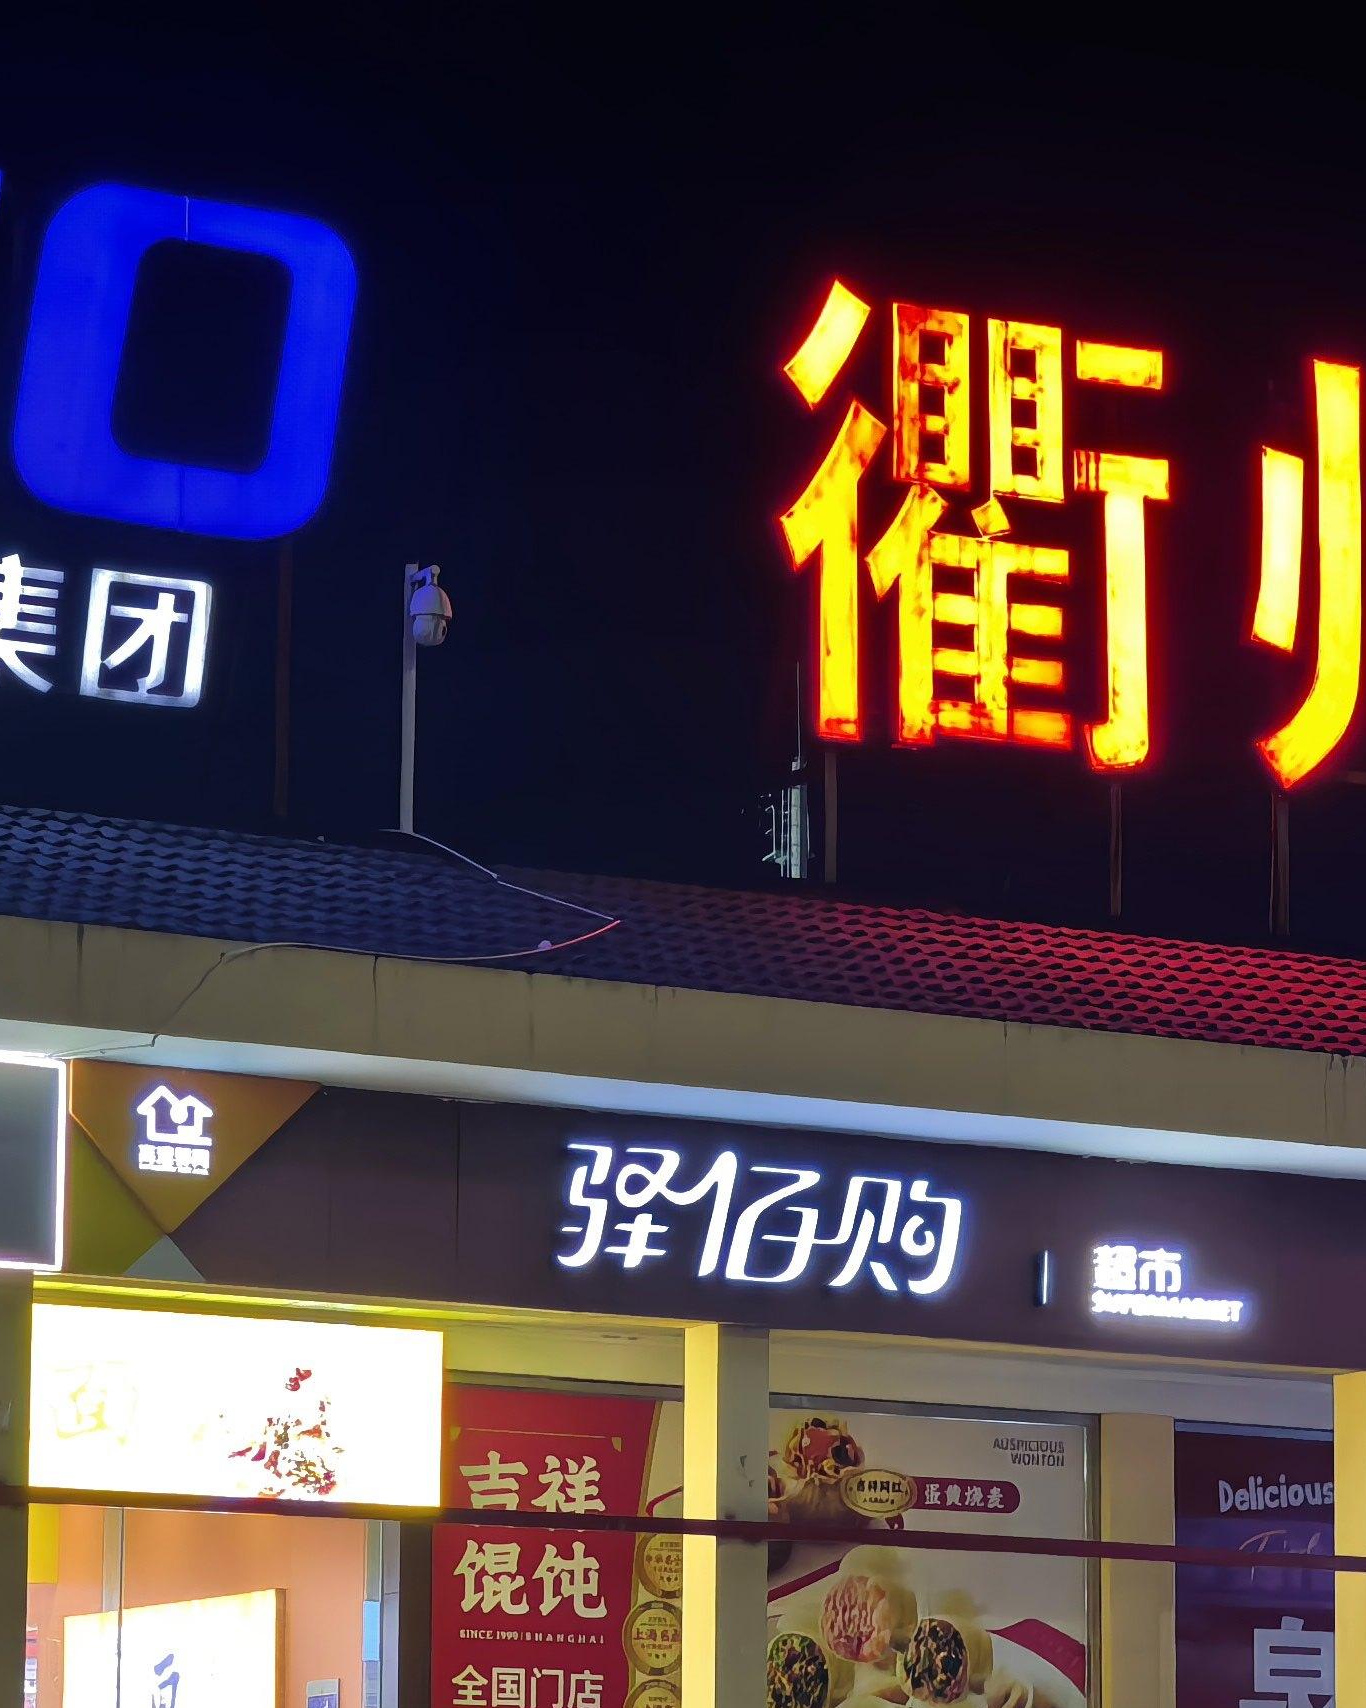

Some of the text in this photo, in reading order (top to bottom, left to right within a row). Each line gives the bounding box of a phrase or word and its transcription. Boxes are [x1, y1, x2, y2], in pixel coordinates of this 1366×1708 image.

[992, 1437, 1066, 1455] AUSPICIOUS
[1011, 1452, 1065, 1468] WONTON
[459, 1450, 606, 1532] 吉祥
[1218, 1474, 1333, 1513] Delicious
[453, 1539, 608, 1618] 馄饨
[459, 1629, 493, 1640] SINCE
[525, 1632, 604, 1645] SHANGHAI
